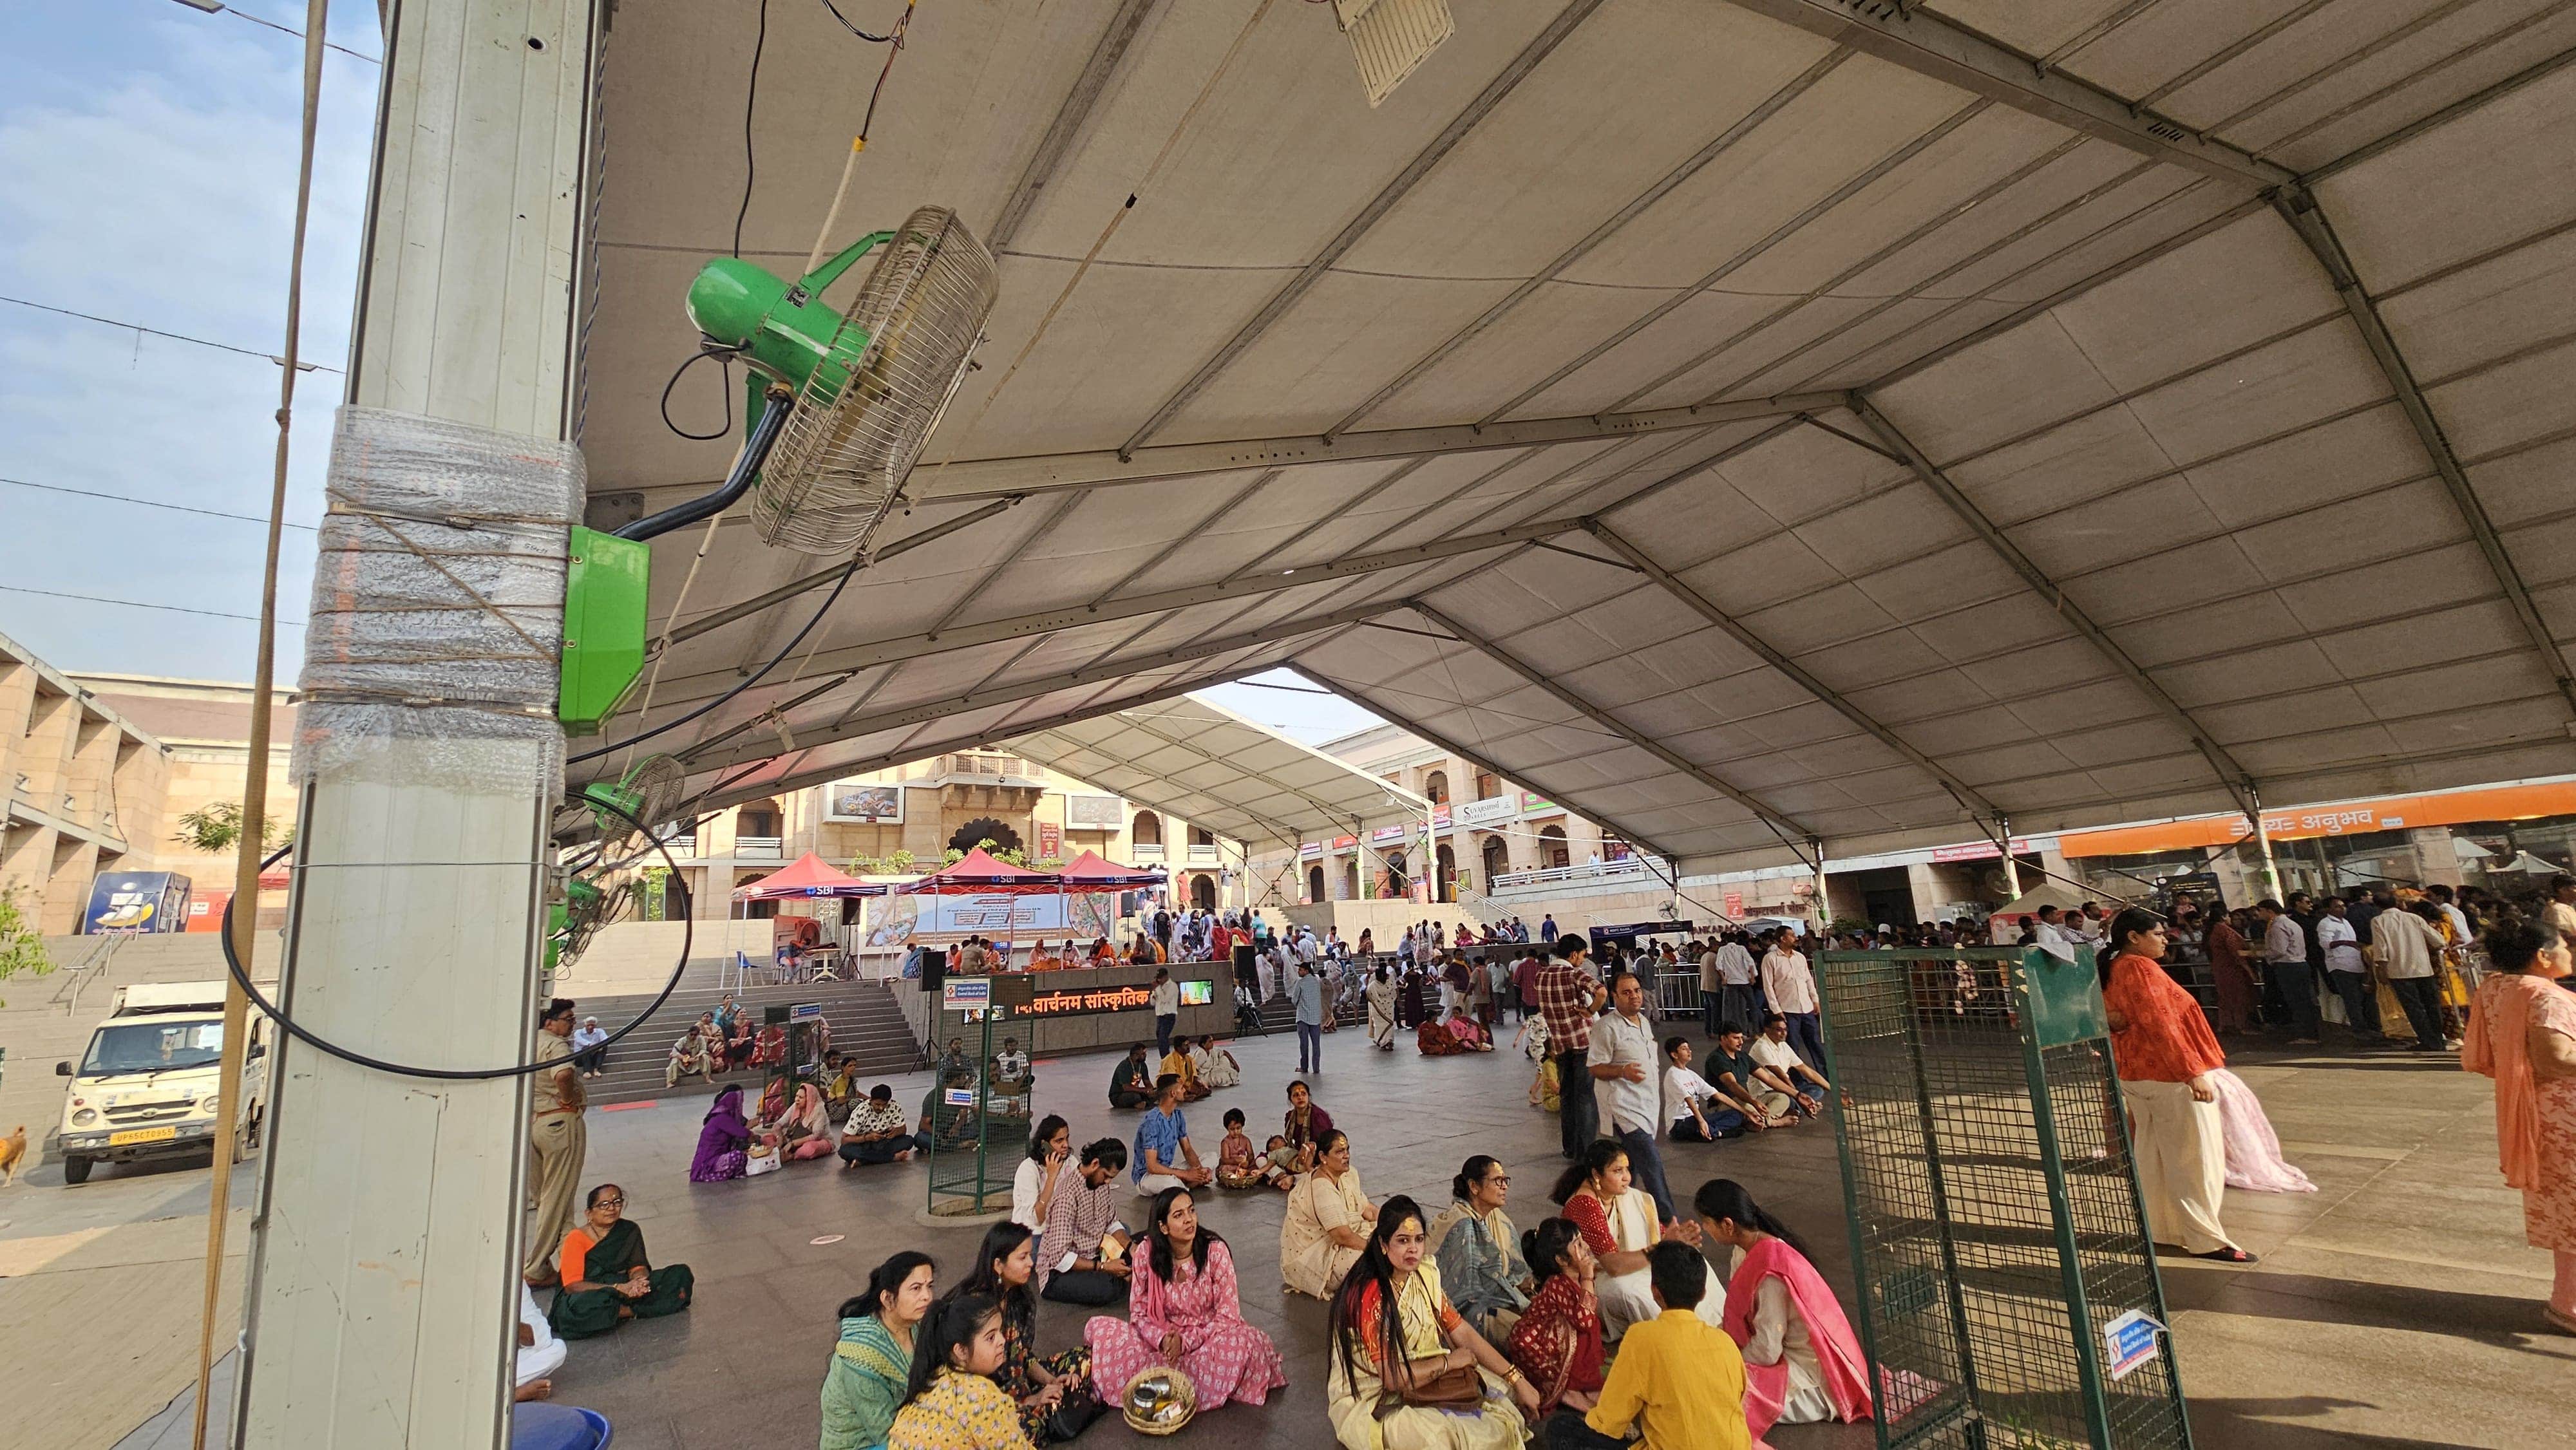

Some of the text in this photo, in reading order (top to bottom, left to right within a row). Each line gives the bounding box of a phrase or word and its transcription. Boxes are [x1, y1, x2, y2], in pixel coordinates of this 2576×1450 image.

[2301, 809, 2373, 832] अनुभव
[817, 886, 834, 895] SBI
[1084, 987, 1150, 1011] सांस्कृतिक
